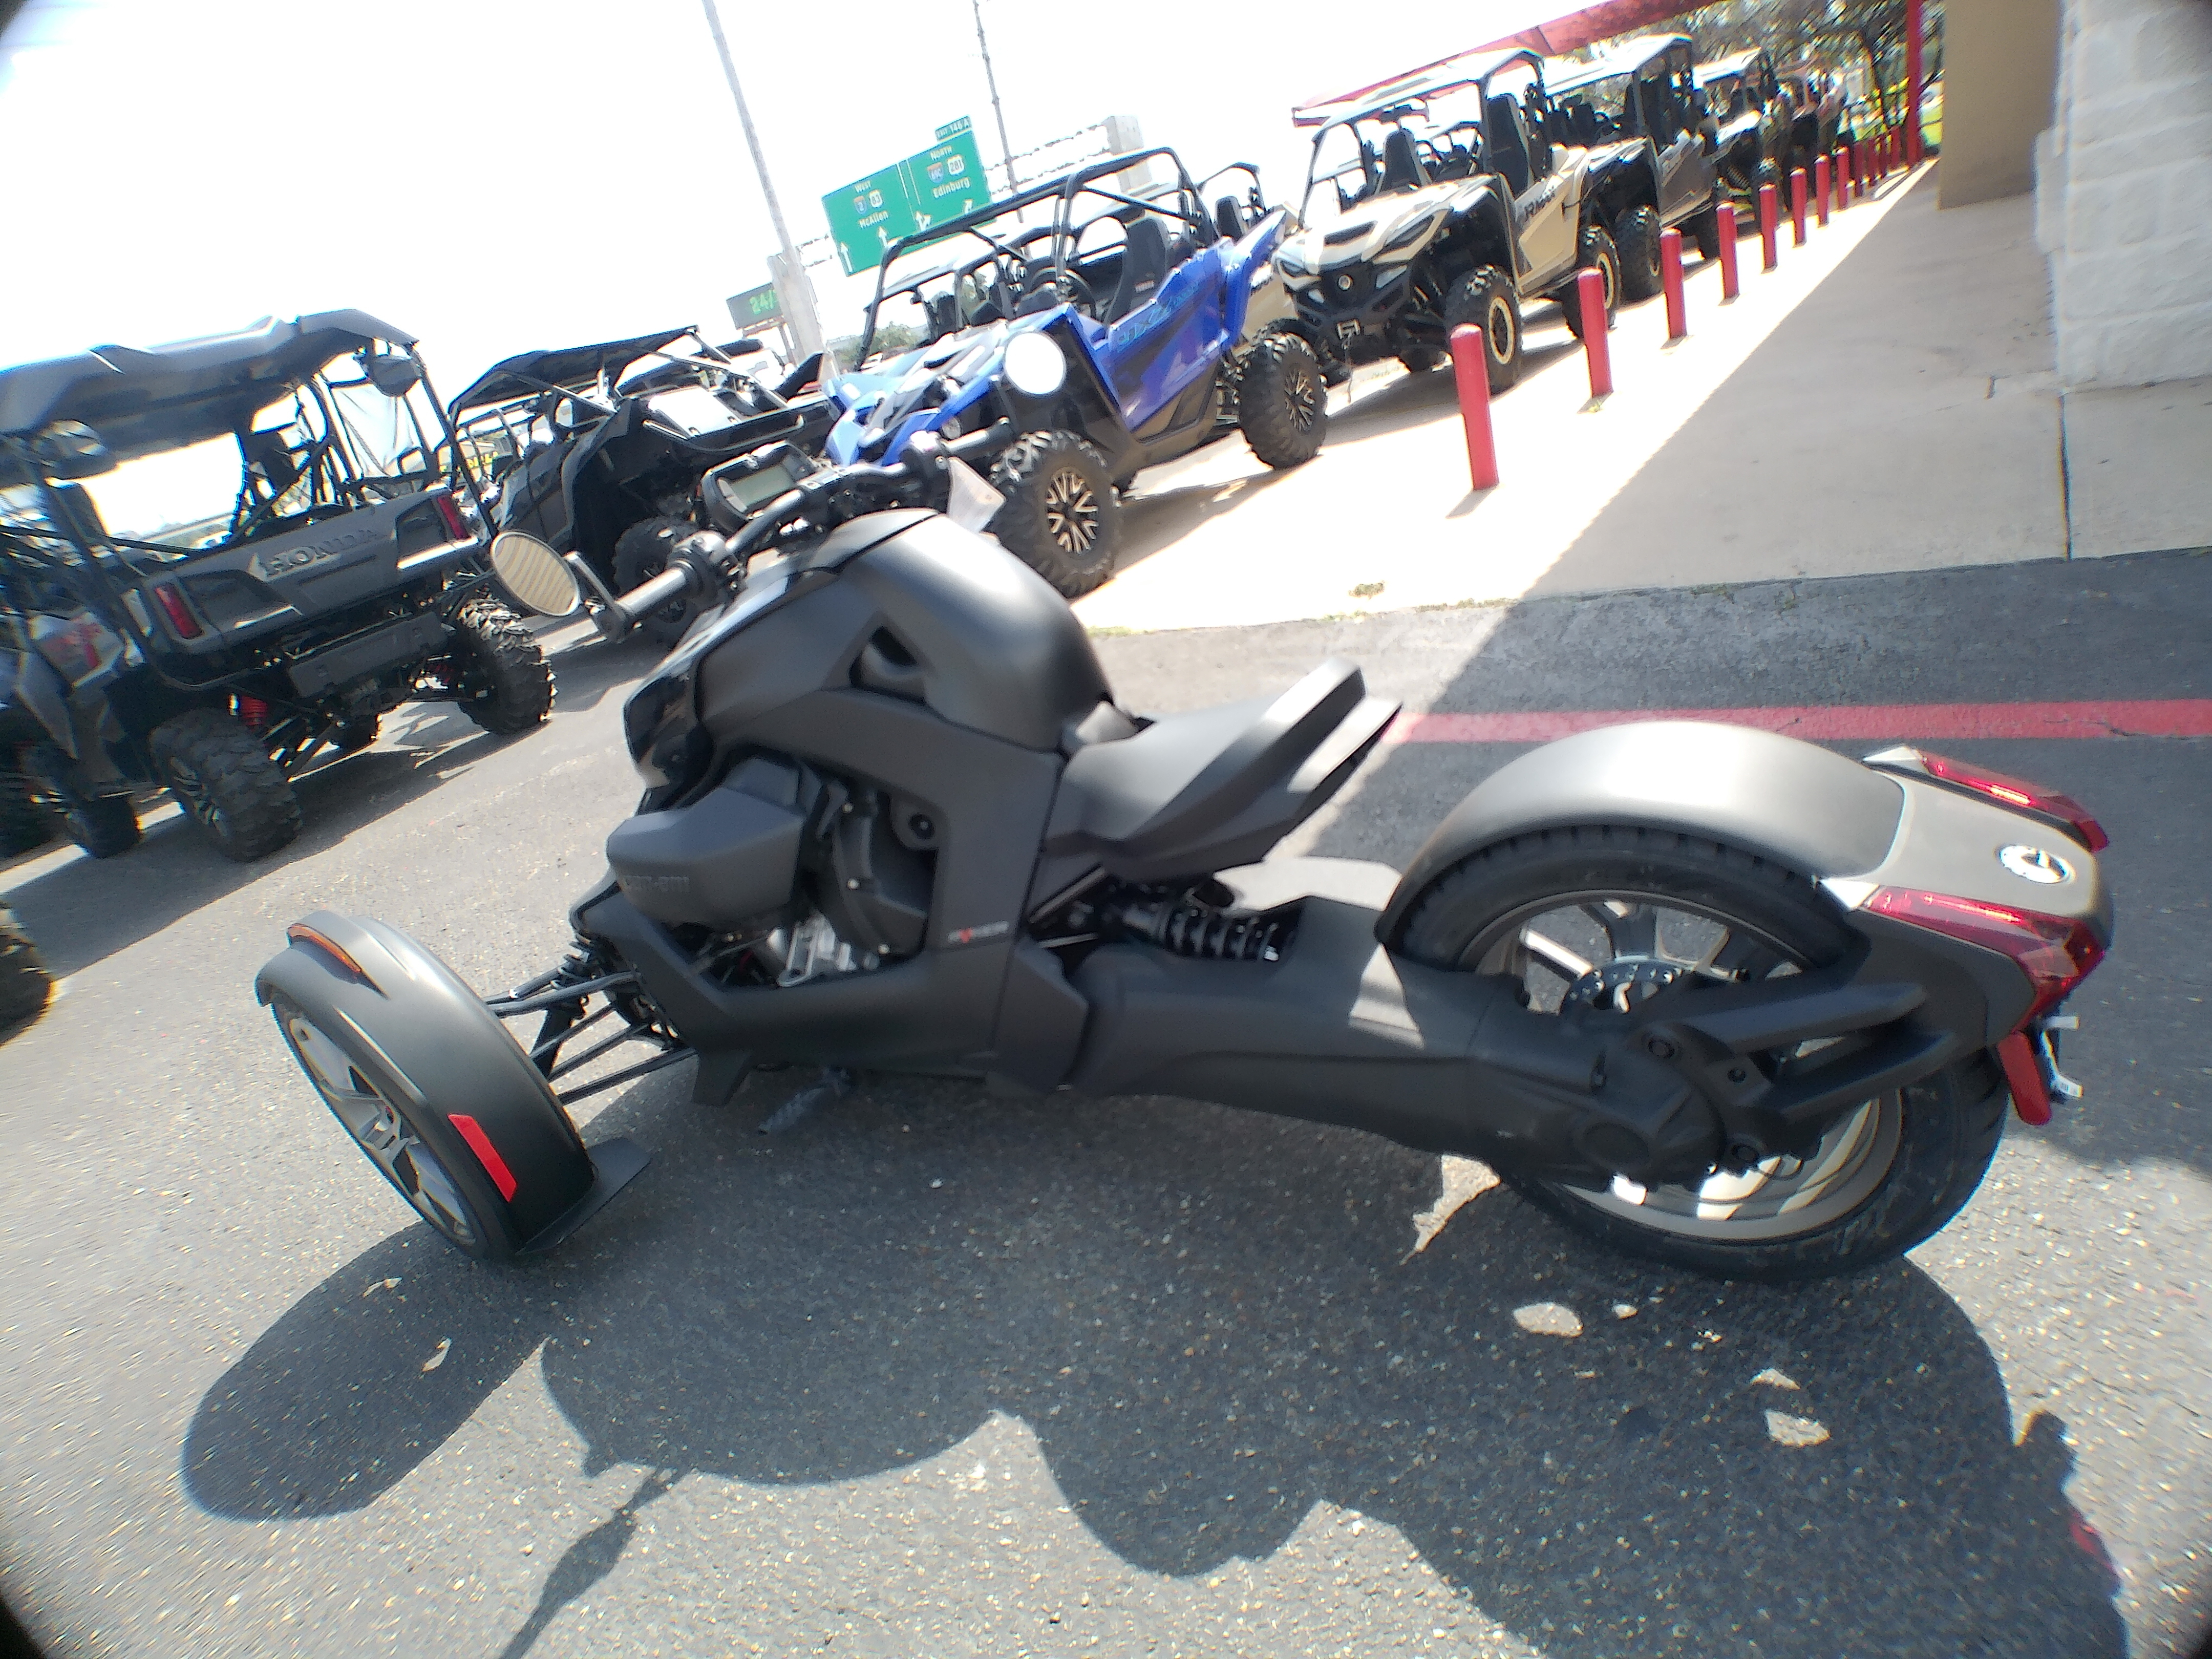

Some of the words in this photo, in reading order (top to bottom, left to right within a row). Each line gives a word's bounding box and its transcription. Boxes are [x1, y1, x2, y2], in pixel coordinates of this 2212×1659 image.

[949, 160, 963, 172] 281
[933, 177, 970, 199] Edinburg
[858, 202, 864, 211] 2
[871, 195, 881, 205] 83
[859, 210, 889, 229] McAllen
